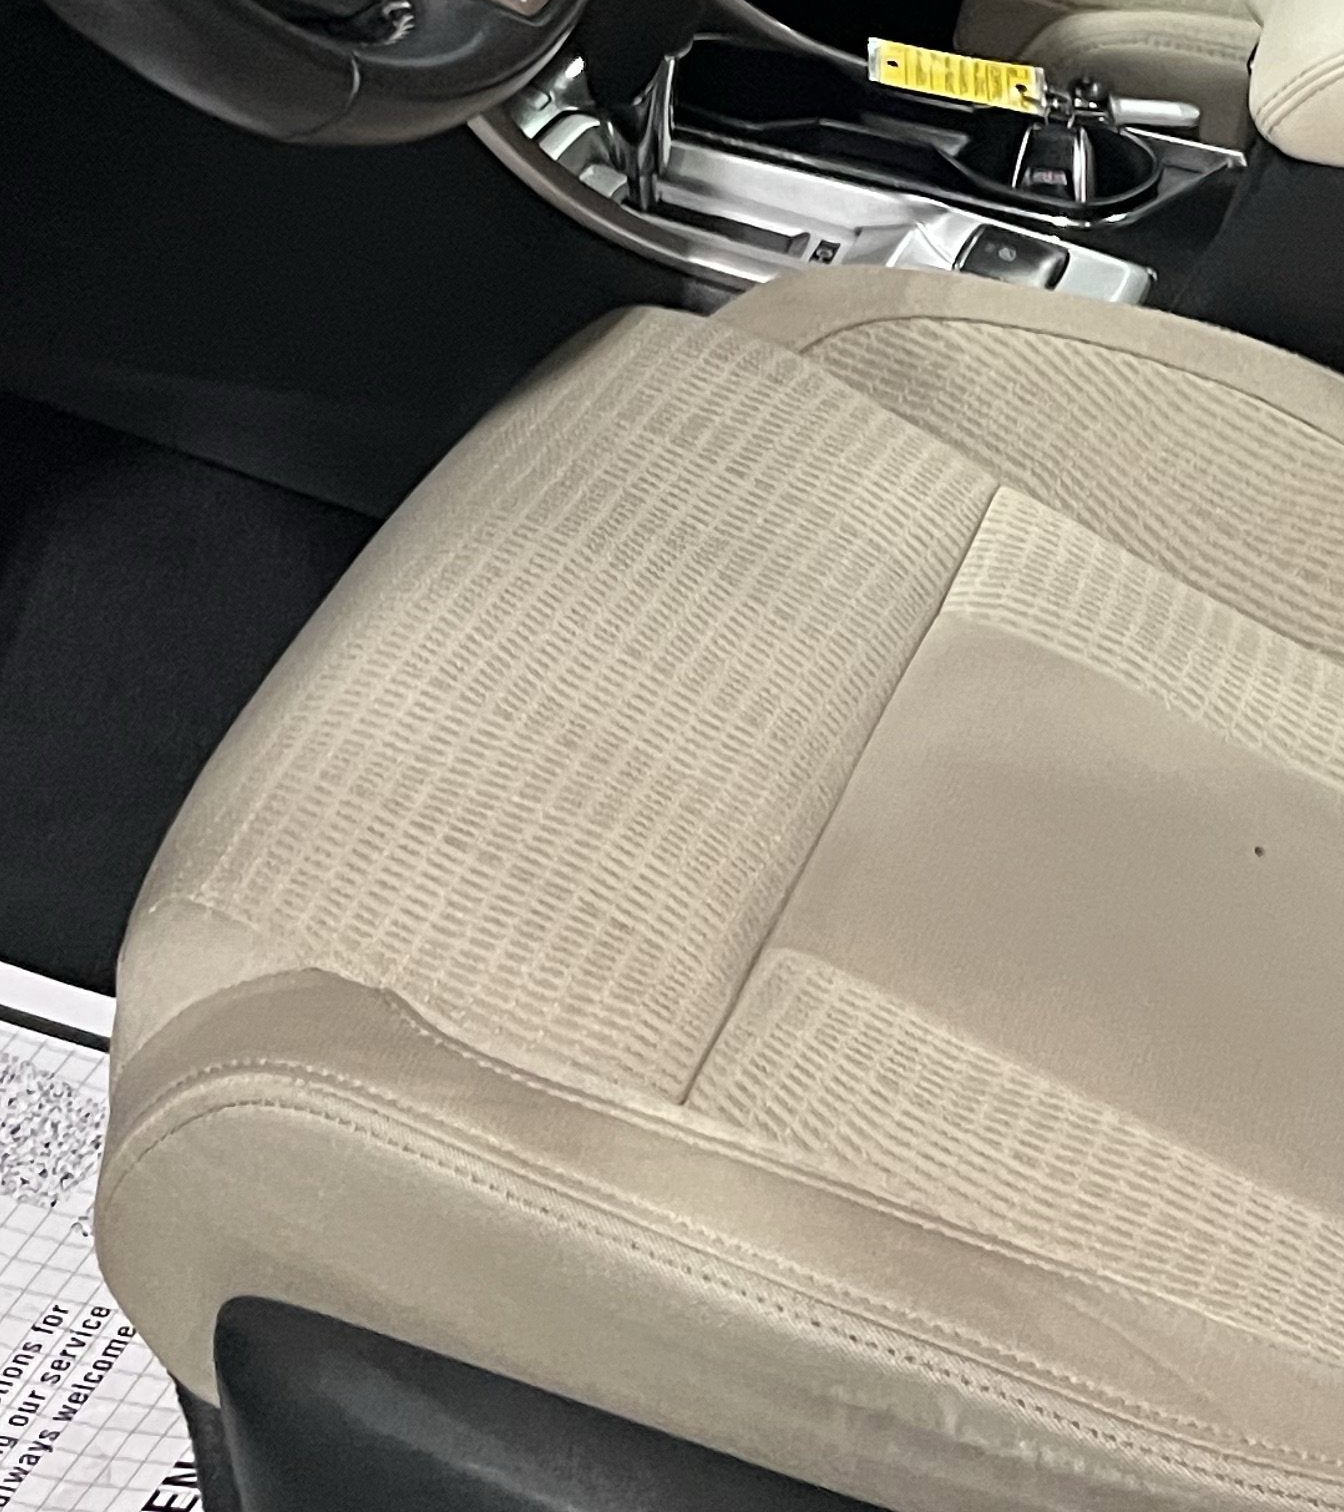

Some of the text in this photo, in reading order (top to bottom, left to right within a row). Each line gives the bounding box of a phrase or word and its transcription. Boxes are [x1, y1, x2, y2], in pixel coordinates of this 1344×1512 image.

[8, 1389, 47, 1429] our
[40, 1305, 112, 1386] service
[31, 1304, 69, 1336] for
[52, 1324, 136, 1423] welcome
